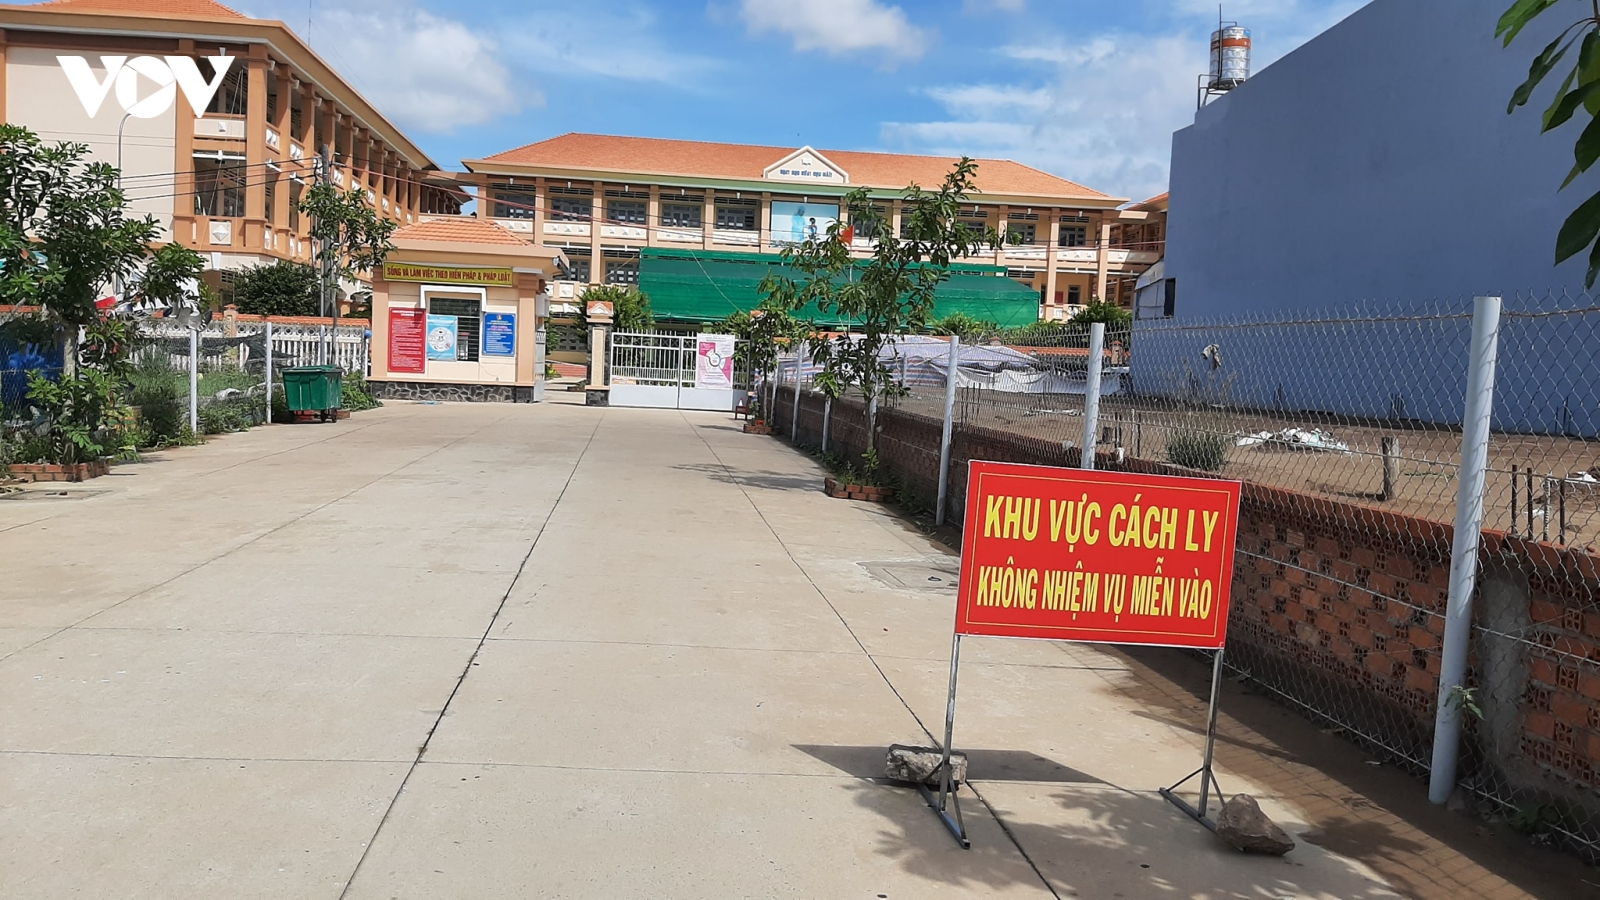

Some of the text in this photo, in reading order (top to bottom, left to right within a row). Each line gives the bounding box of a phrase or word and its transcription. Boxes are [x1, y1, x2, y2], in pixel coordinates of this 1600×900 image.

[422, 268, 434, 279] VIỆC
[435, 270, 448, 279] THEO
[462, 270, 476, 280] PHÁP
[483, 271, 497, 281] PHÁP
[983, 492, 1219, 553] KHU VỰC CÁCH LY
[976, 555, 1212, 623] KHÔNG NHIỆM VỤ MIỄN VÀO
